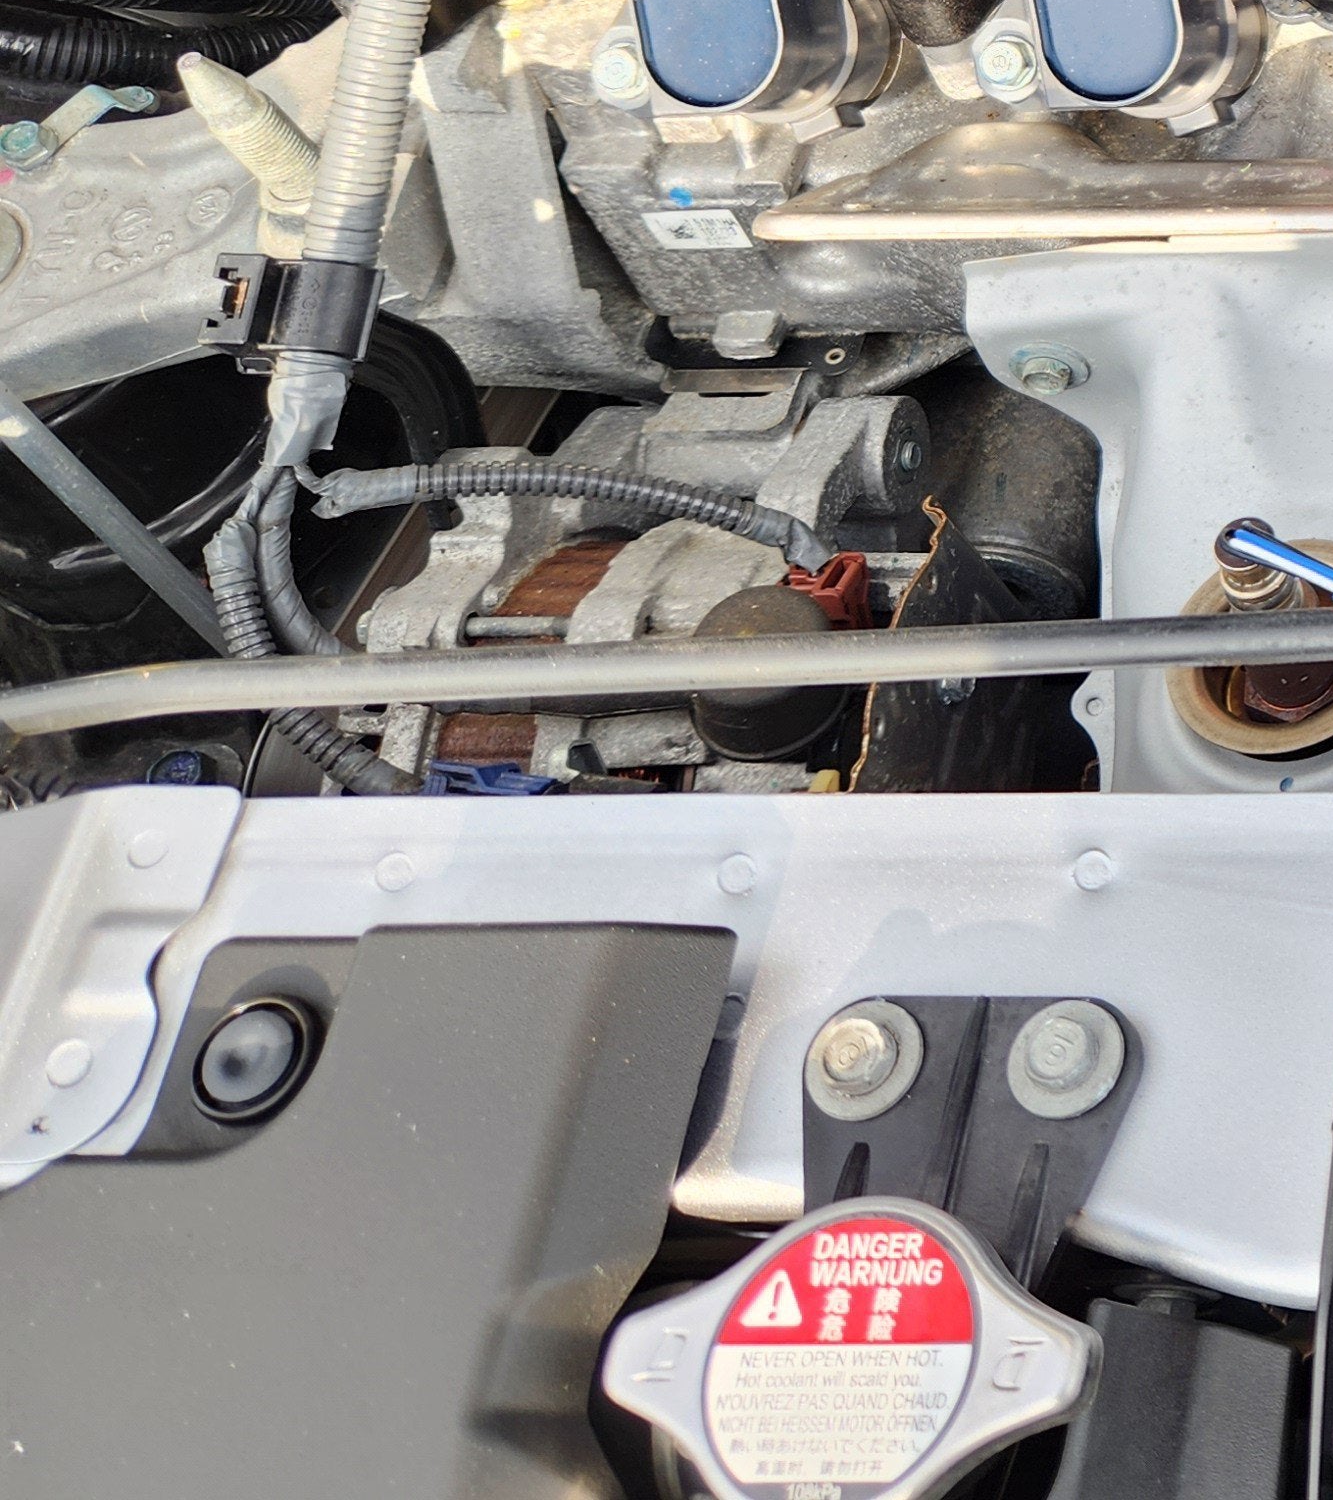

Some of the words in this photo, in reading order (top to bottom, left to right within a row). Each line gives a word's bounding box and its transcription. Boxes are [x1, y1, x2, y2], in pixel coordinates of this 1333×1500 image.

[812, 1232, 925, 1260] DANGER
[809, 1258, 944, 1287] WARNUNG
[740, 1351, 797, 1368] NEVER
[801, 1350, 848, 1367] OPEN
[851, 1350, 901, 1367] WHEN
[905, 1349, 944, 1368] HOT.
[735, 1373, 762, 1388] Hot
[765, 1372, 819, 1388] coolant
[822, 1371, 846, 1387] will
[849, 1371, 888, 1387] scald
[798, 1393, 833, 1410] PAS
[833, 1393, 891, 1411] QUAND
[718, 1415, 755, 1433] NICHT
[757, 1416, 777, 1432] BEI
[780, 1415, 836, 1433] HEISSEM
[838, 1415, 885, 1432] MOTOR
